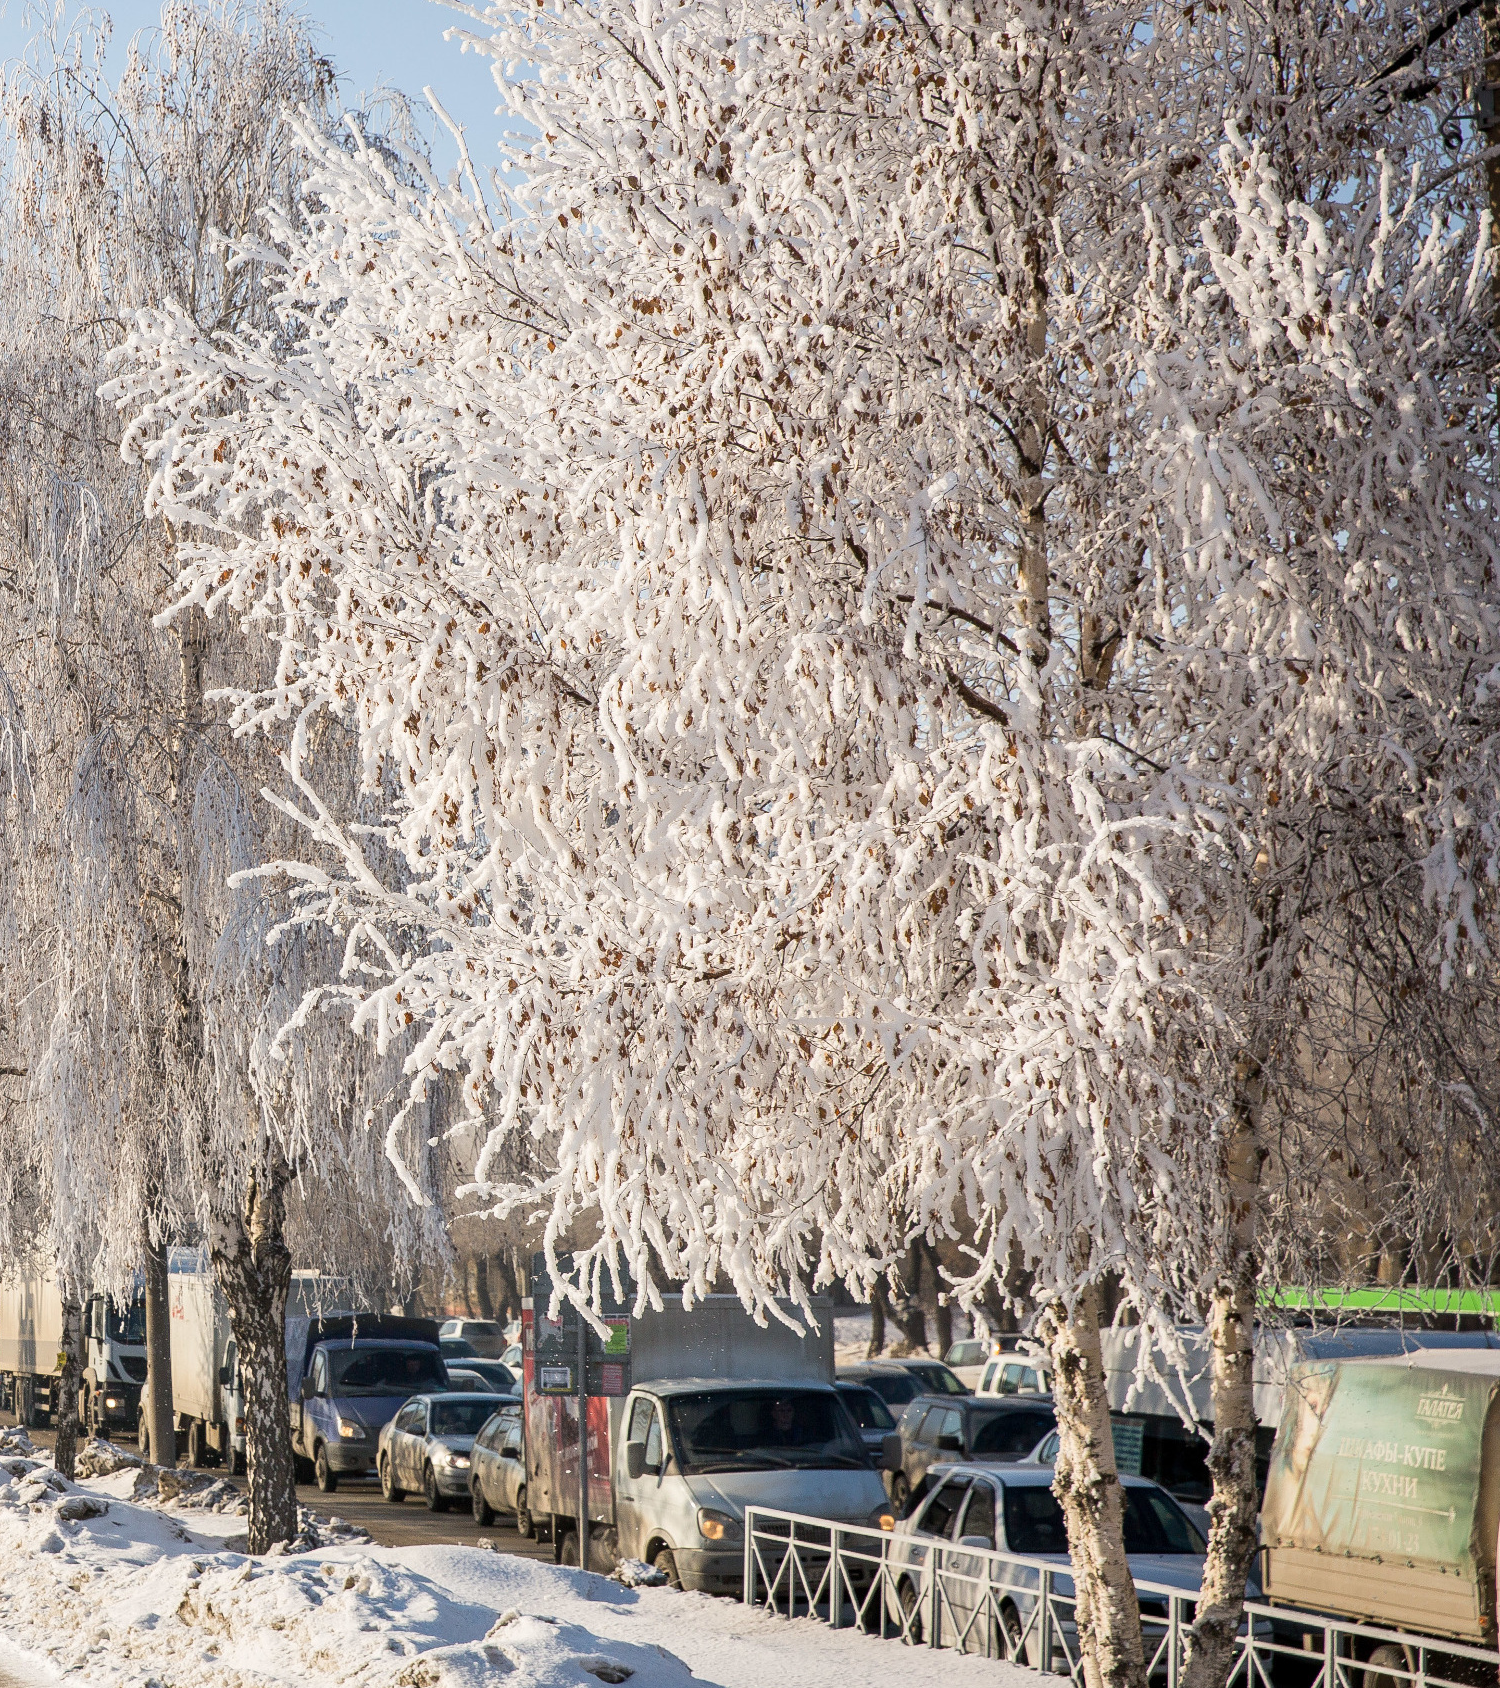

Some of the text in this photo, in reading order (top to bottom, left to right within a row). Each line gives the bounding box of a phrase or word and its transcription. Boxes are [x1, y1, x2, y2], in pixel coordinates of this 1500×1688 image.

[1417, 1399, 1464, 1419] ГАЛАТЕЯ
[1338, 1437, 1446, 1471] ШКАФЫ-КУПЕ
[1362, 1470, 1419, 1498] КУХНИ
